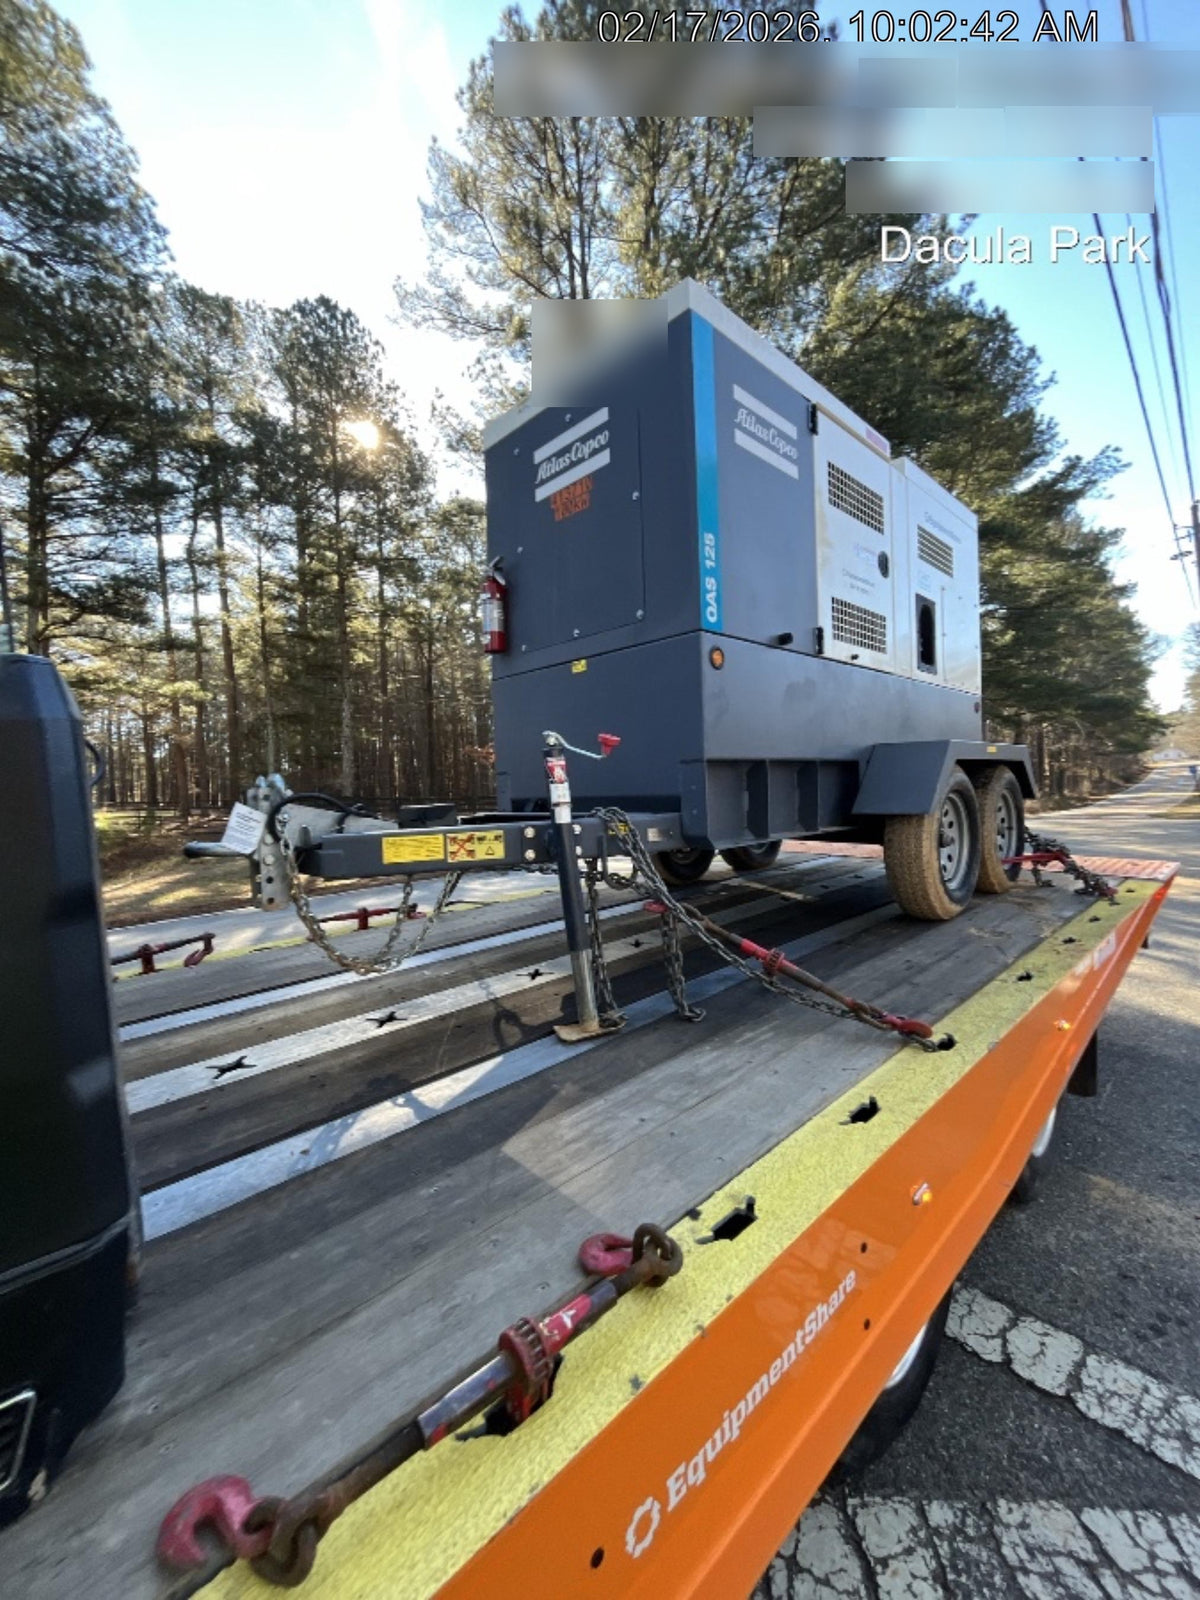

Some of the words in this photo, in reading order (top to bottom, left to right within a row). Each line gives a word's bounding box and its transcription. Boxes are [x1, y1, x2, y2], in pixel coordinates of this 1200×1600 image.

[535, 452, 571, 485] Atlas
[571, 429, 609, 462] Copco
[735, 408, 768, 442] Atlas
[769, 427, 799, 460] Copco
[703, 532, 716, 569] 125
[666, 1269, 856, 1513] EquipmentShare
